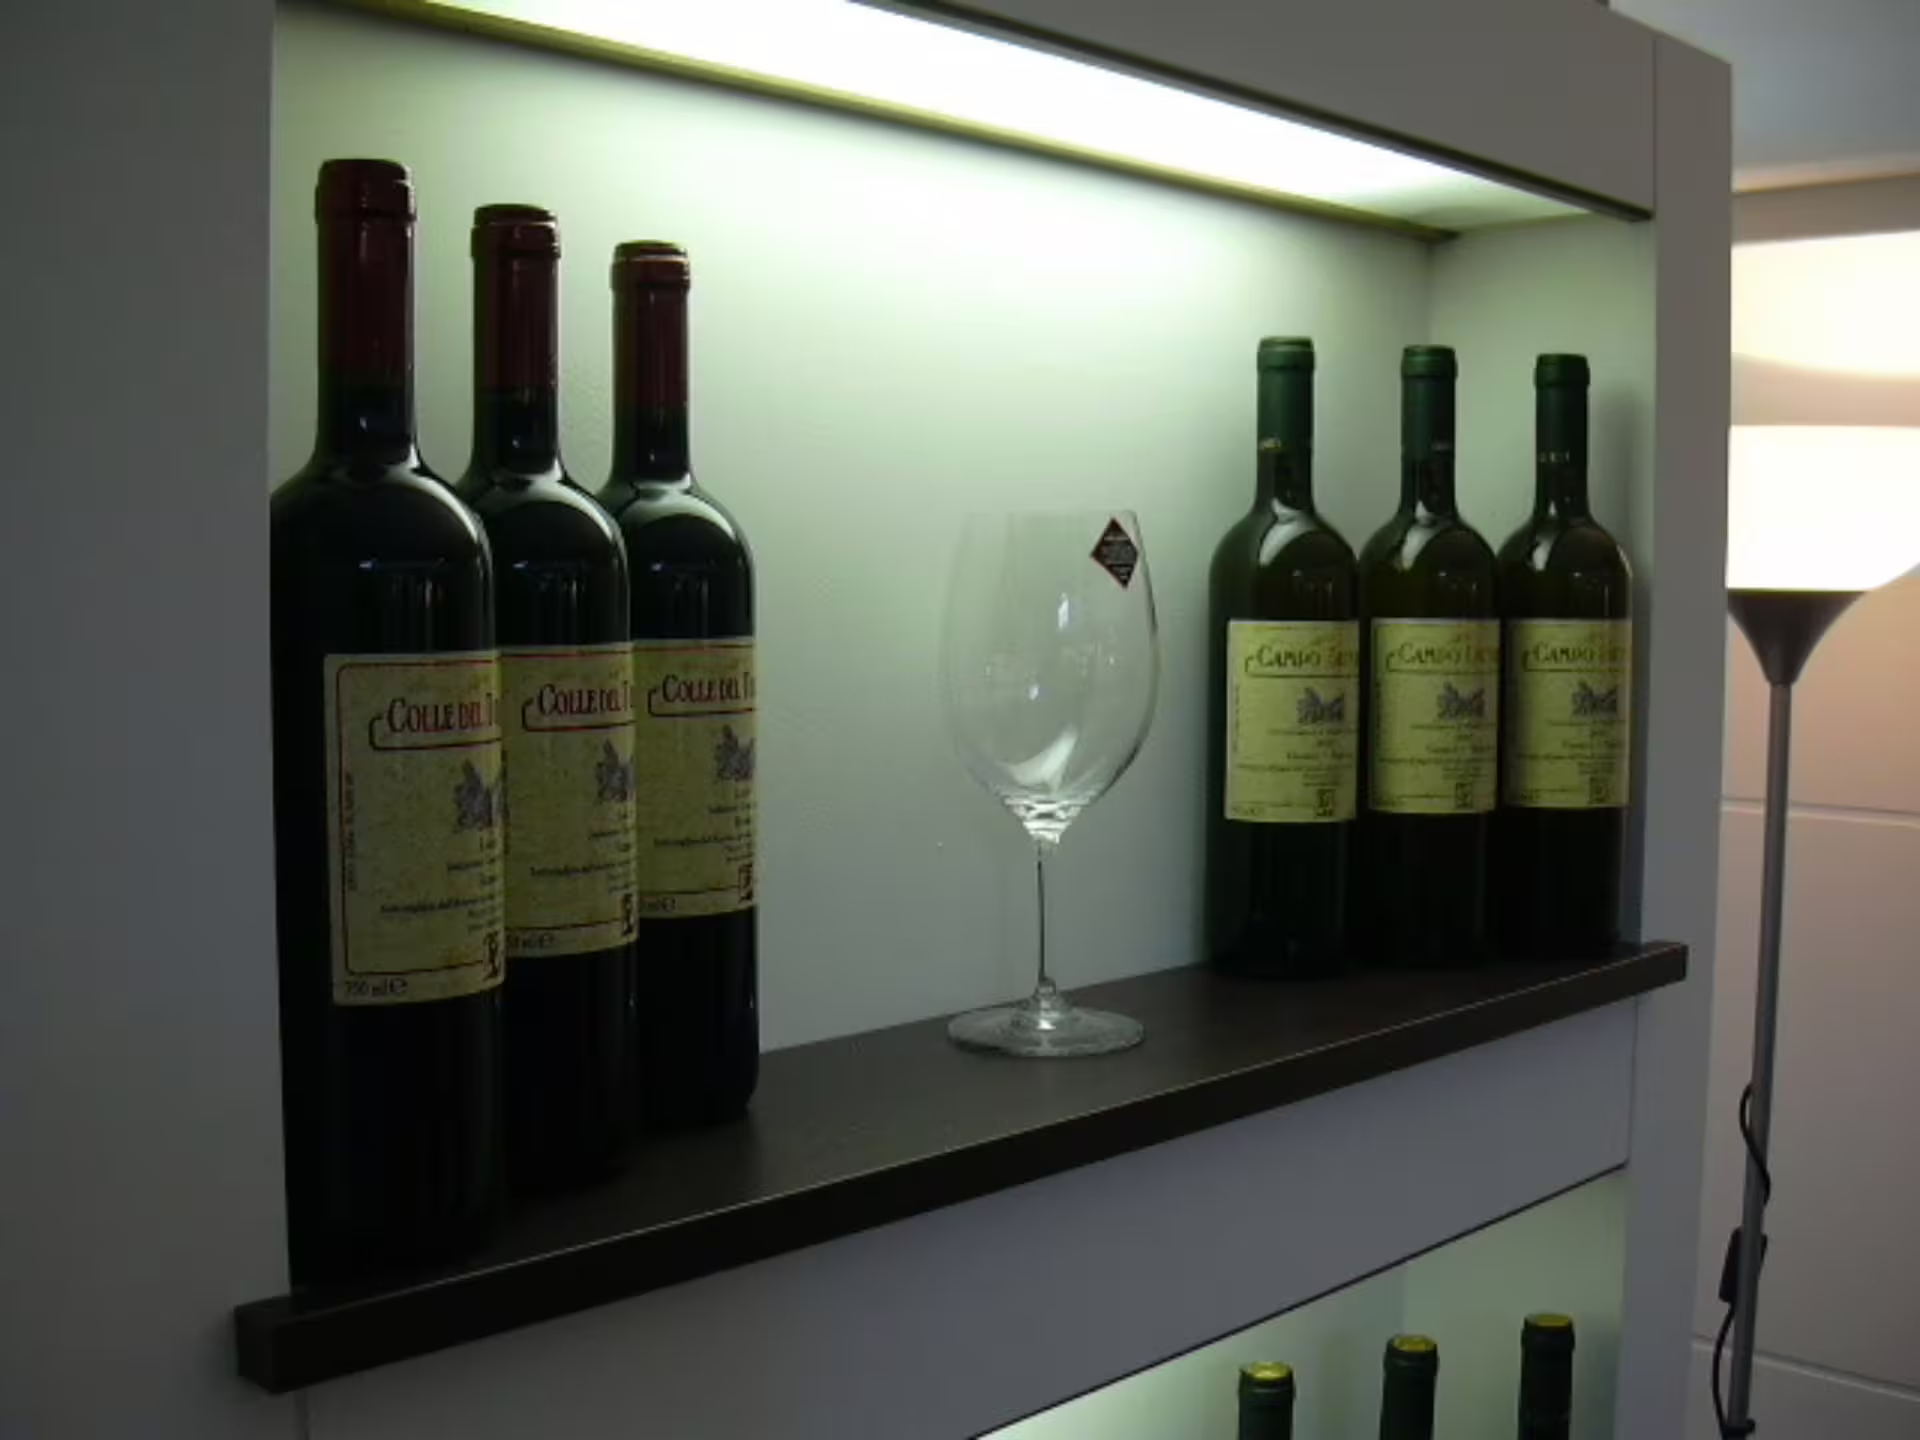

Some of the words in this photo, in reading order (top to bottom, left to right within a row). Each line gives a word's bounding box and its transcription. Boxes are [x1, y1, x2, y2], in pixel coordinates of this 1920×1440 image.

[538, 683, 597, 715] COLLE
[662, 674, 717, 703] COLLE
[387, 697, 454, 733] COLLE
